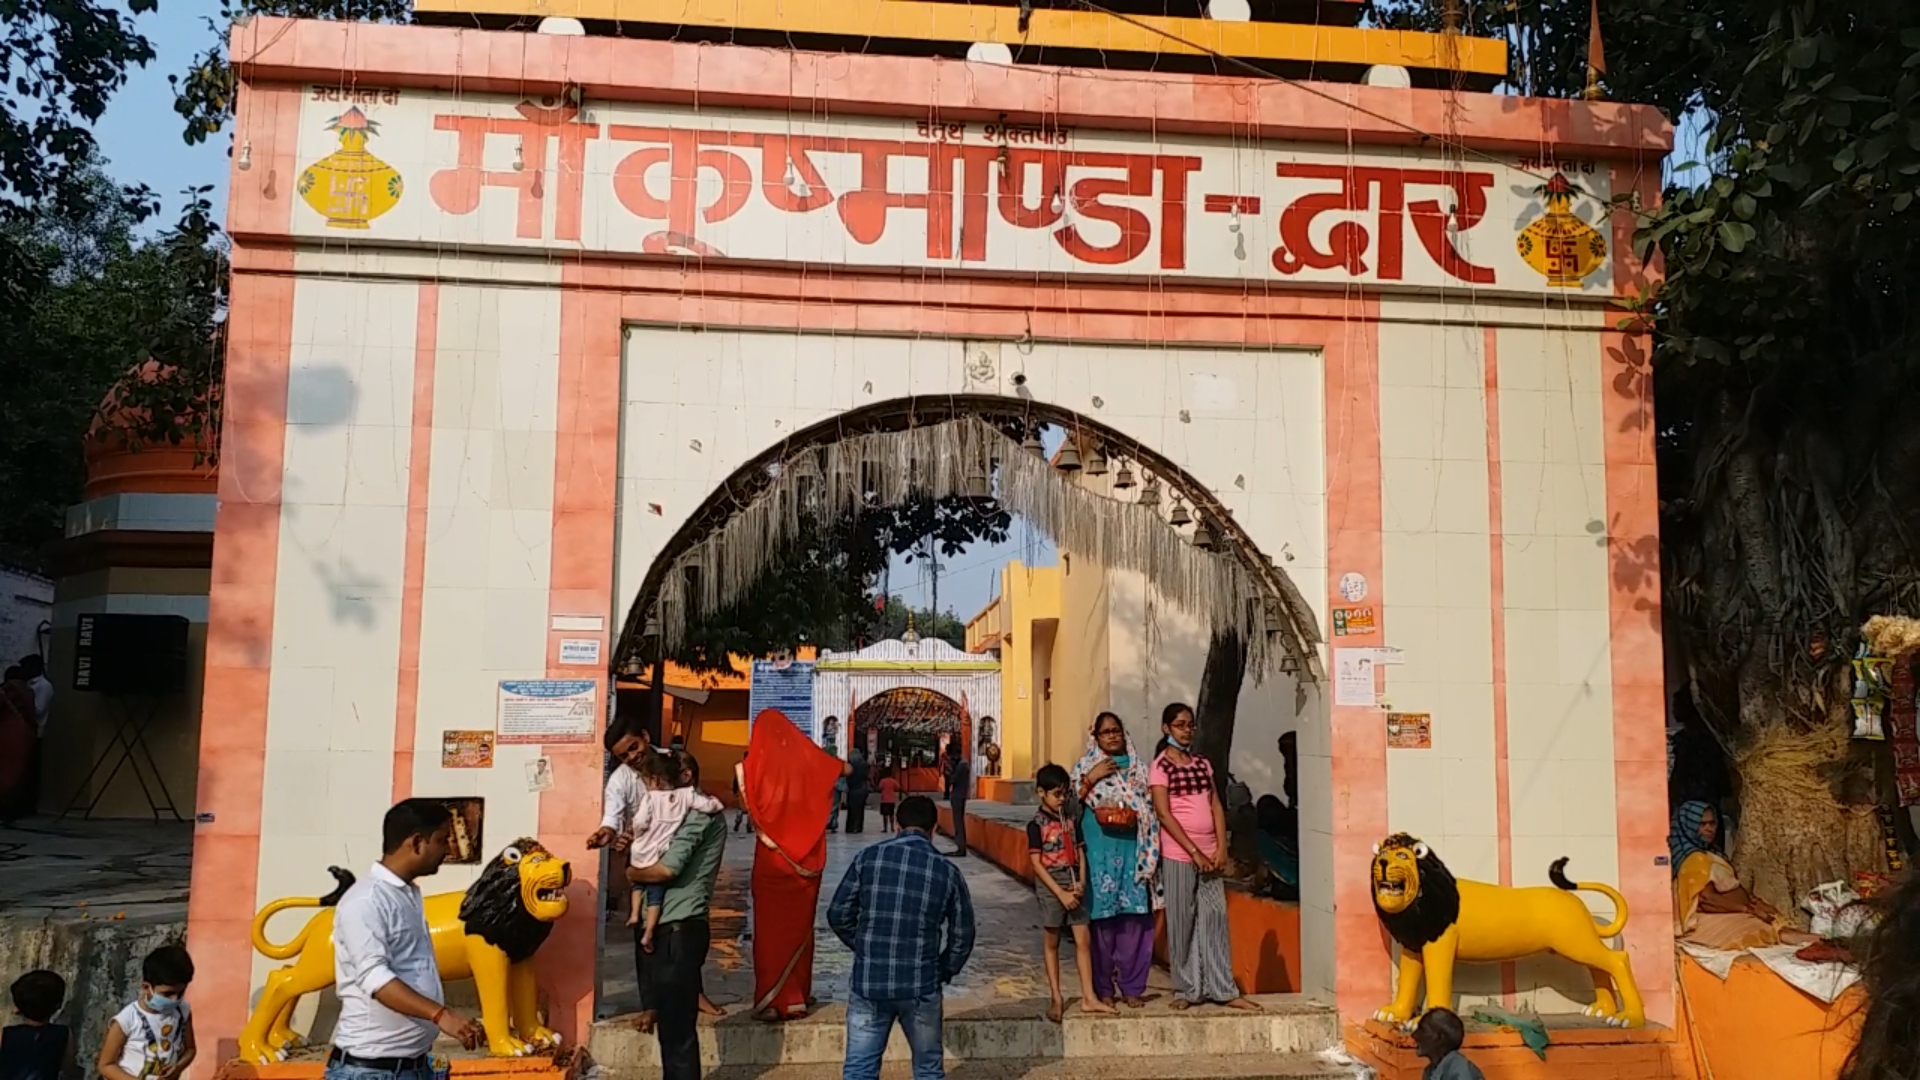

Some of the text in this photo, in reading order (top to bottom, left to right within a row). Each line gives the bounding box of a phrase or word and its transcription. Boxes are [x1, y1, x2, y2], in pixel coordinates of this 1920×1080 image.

[311, 85, 340, 102] जय
[429, 95, 600, 240] माँ
[79, 617, 94, 646] RAVI
[76, 656, 91, 686] RAVI
